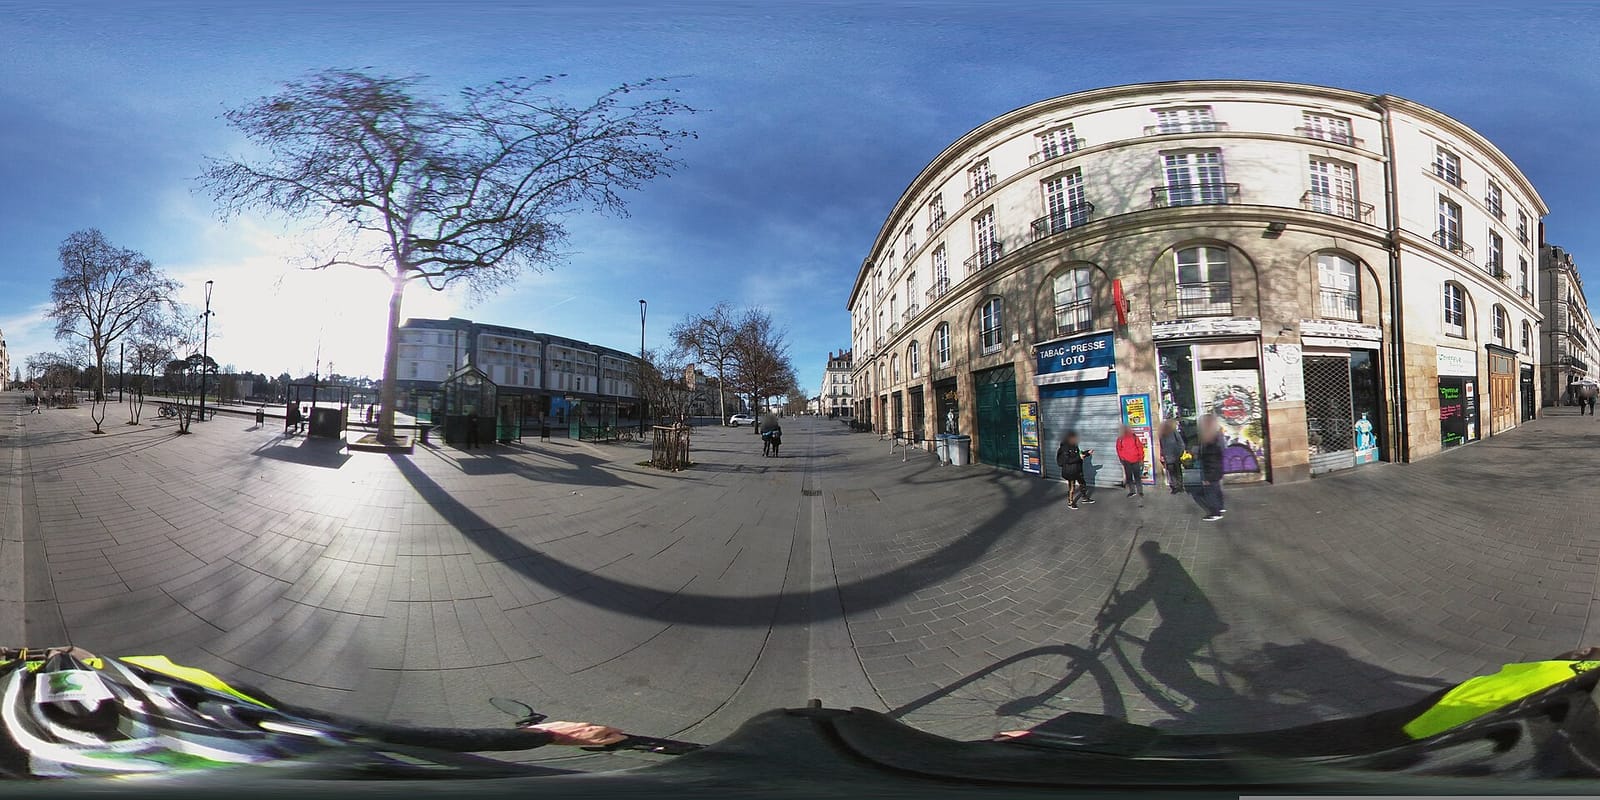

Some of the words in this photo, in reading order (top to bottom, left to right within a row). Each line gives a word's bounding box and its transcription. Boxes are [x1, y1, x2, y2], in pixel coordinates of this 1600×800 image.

[1040, 347, 1064, 359] TABAC
[1071, 341, 1105, 353] PRESSE
[1061, 354, 1085, 366] LOTO
